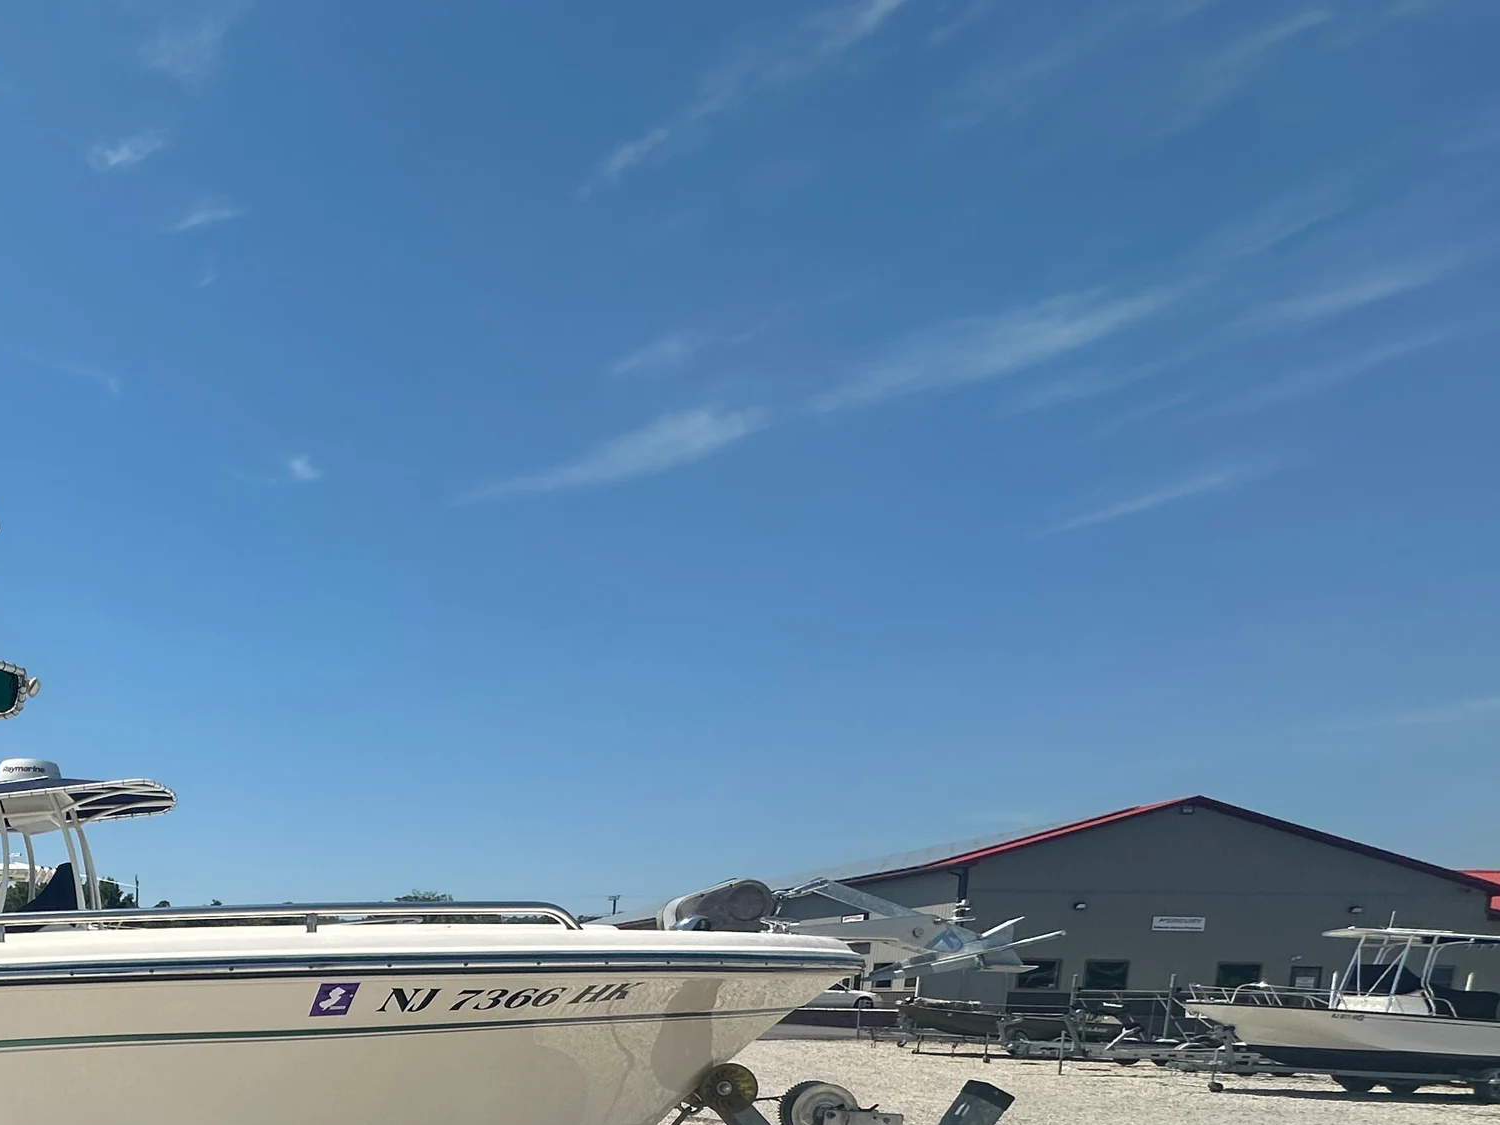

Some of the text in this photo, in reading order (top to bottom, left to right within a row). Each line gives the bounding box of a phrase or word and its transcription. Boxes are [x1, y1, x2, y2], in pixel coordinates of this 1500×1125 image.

[376, 981, 645, 1013] NJ 7366 HK
